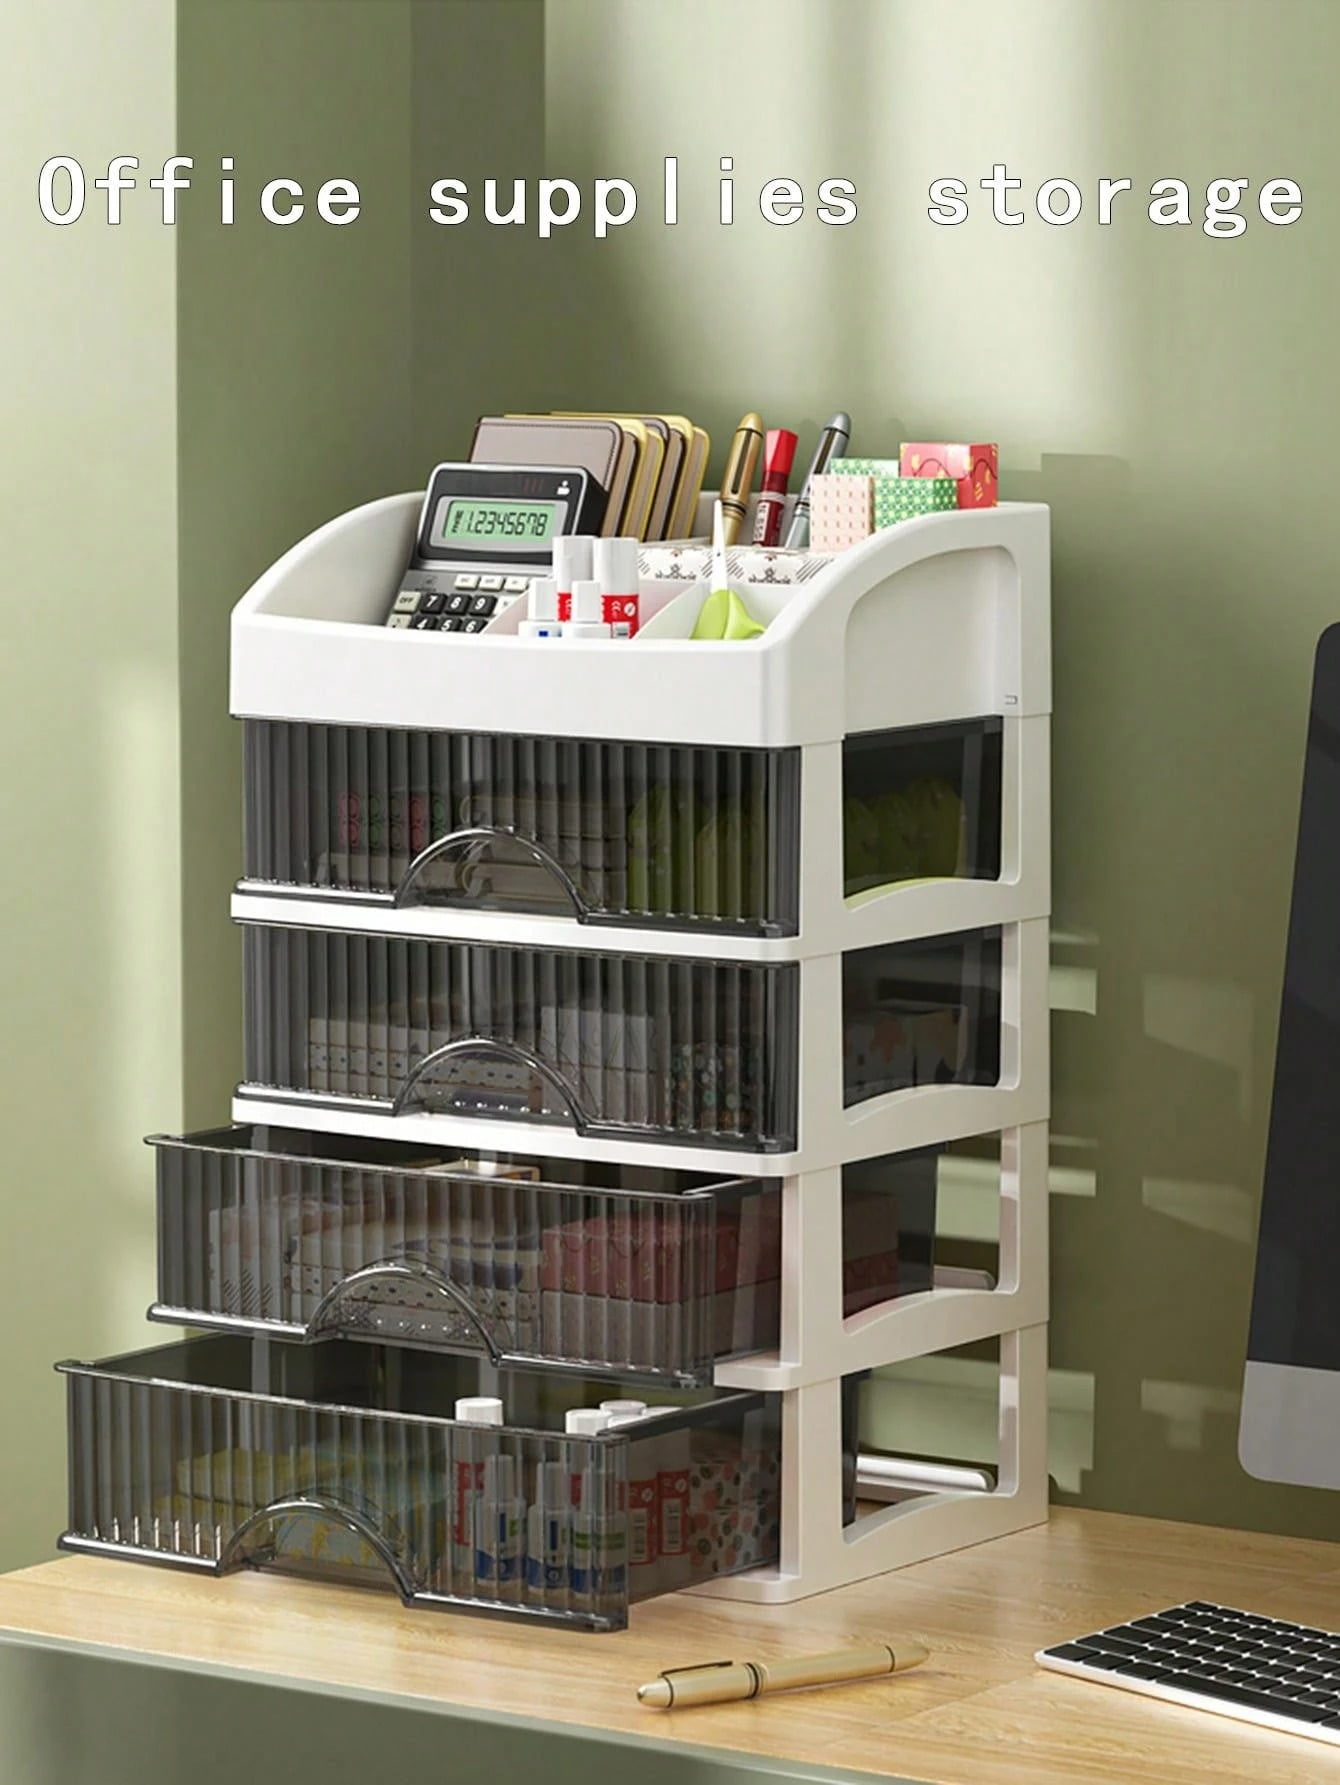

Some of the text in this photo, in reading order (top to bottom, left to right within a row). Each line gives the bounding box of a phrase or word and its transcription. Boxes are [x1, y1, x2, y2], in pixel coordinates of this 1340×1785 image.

[426, 594, 438, 608] 7
[450, 596, 462, 609] 8
[475, 597, 486, 610] 9
[417, 619, 477, 633] 4 5 6
